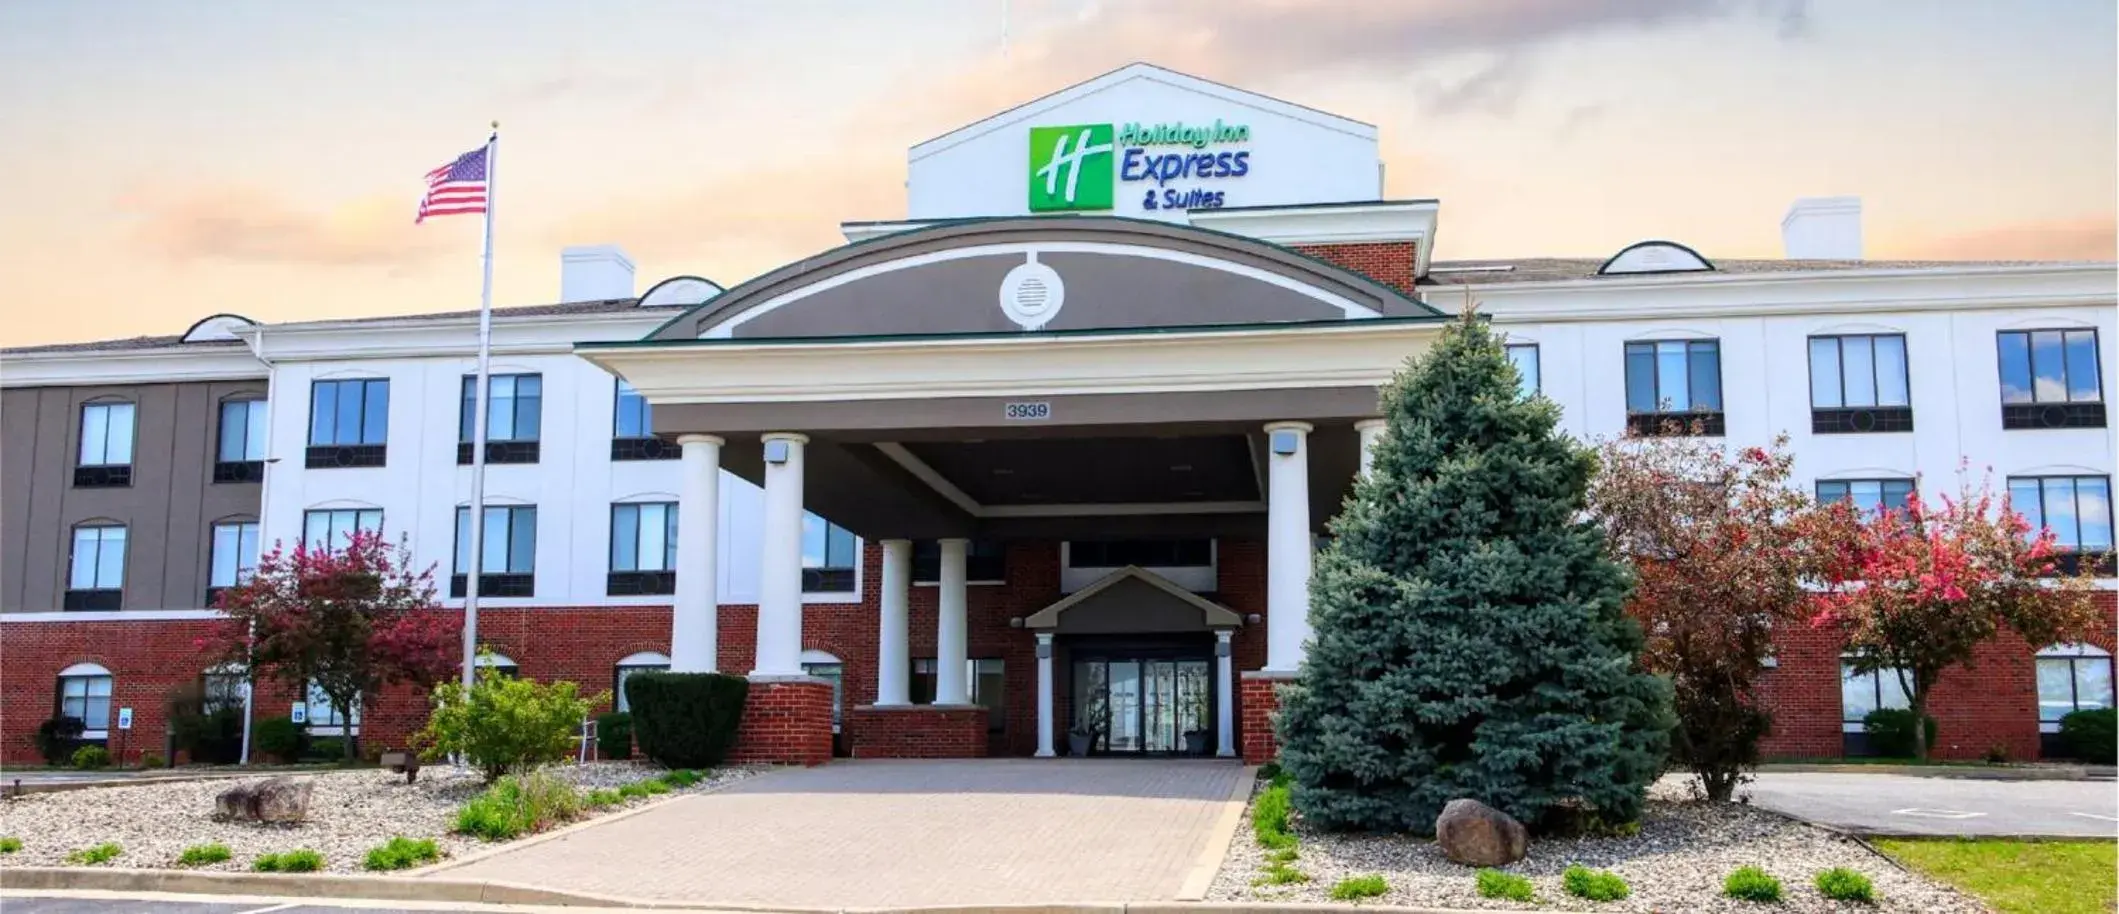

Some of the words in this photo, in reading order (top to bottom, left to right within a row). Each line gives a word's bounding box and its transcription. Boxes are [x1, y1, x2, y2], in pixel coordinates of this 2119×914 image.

[1120, 121, 1208, 148] Holiday
[1213, 119, 1249, 143] Inn
[1036, 128, 1112, 202] H
[1121, 148, 1249, 187] Express
[1143, 190, 1158, 209] &
[1163, 188, 1225, 210] Suites
[1007, 404, 1048, 418] 3939
